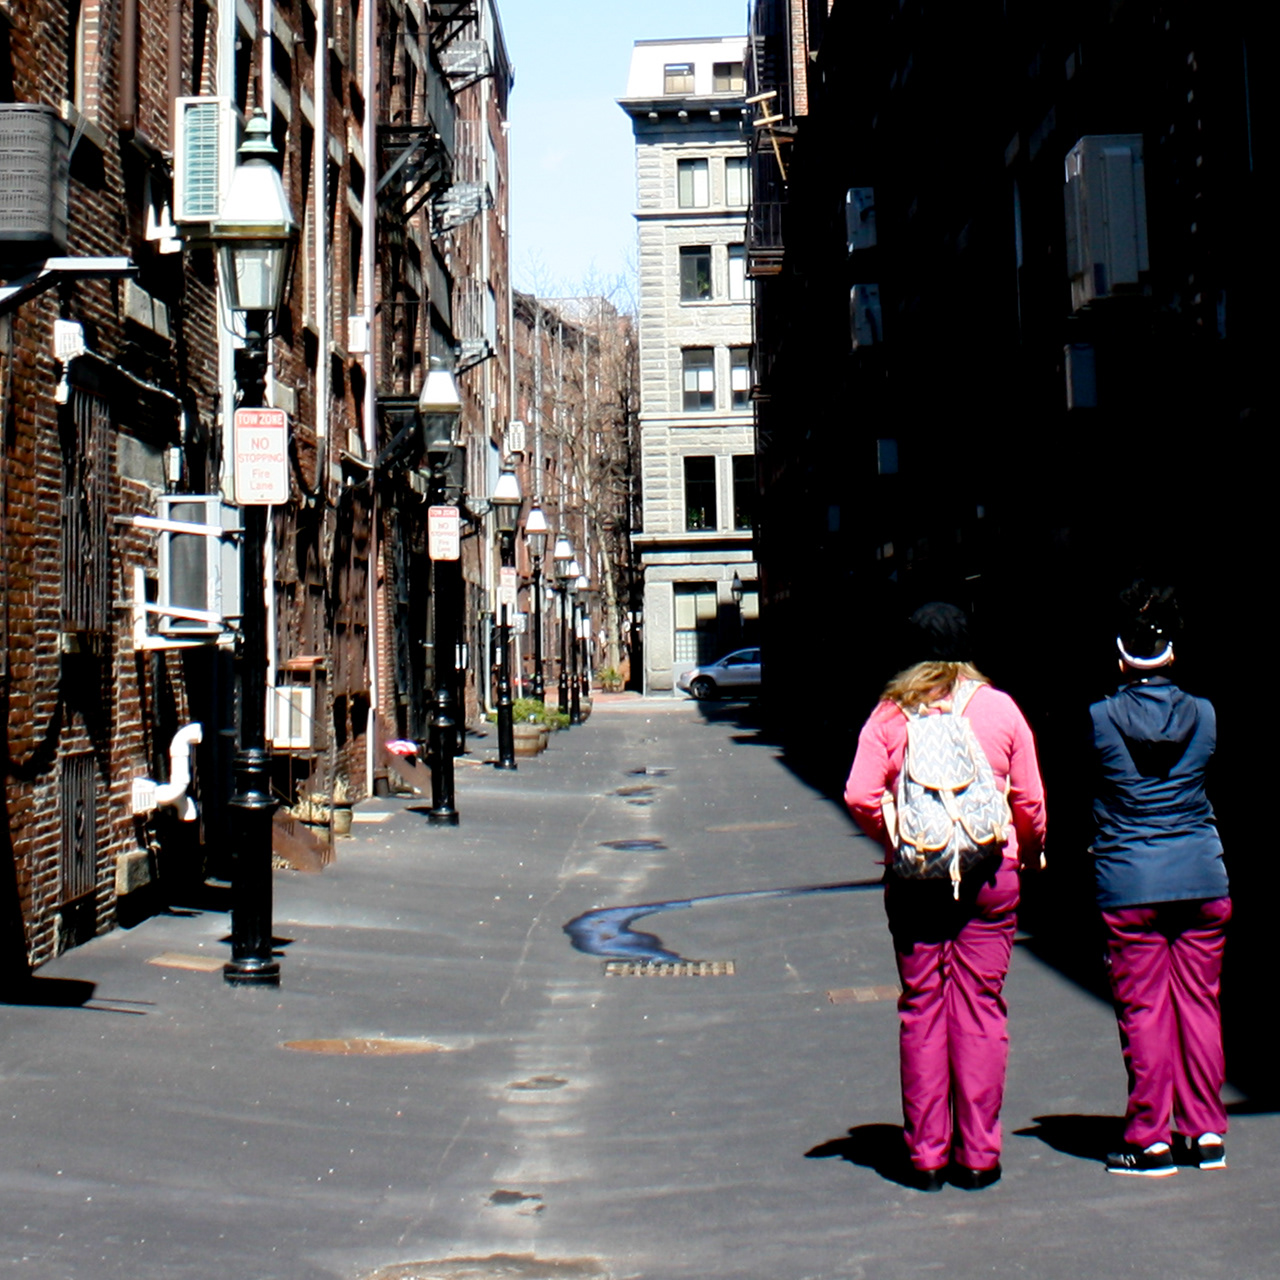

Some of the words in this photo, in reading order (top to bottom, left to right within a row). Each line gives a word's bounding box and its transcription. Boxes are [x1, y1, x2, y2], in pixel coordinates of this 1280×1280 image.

[237, 413, 258, 425] TOW
[259, 413, 283, 425] ZONE
[251, 437, 270, 450] NO
[238, 453, 284, 463] STOPPING
[252, 468, 271, 479] Fire
[249, 481, 273, 490] Lane
